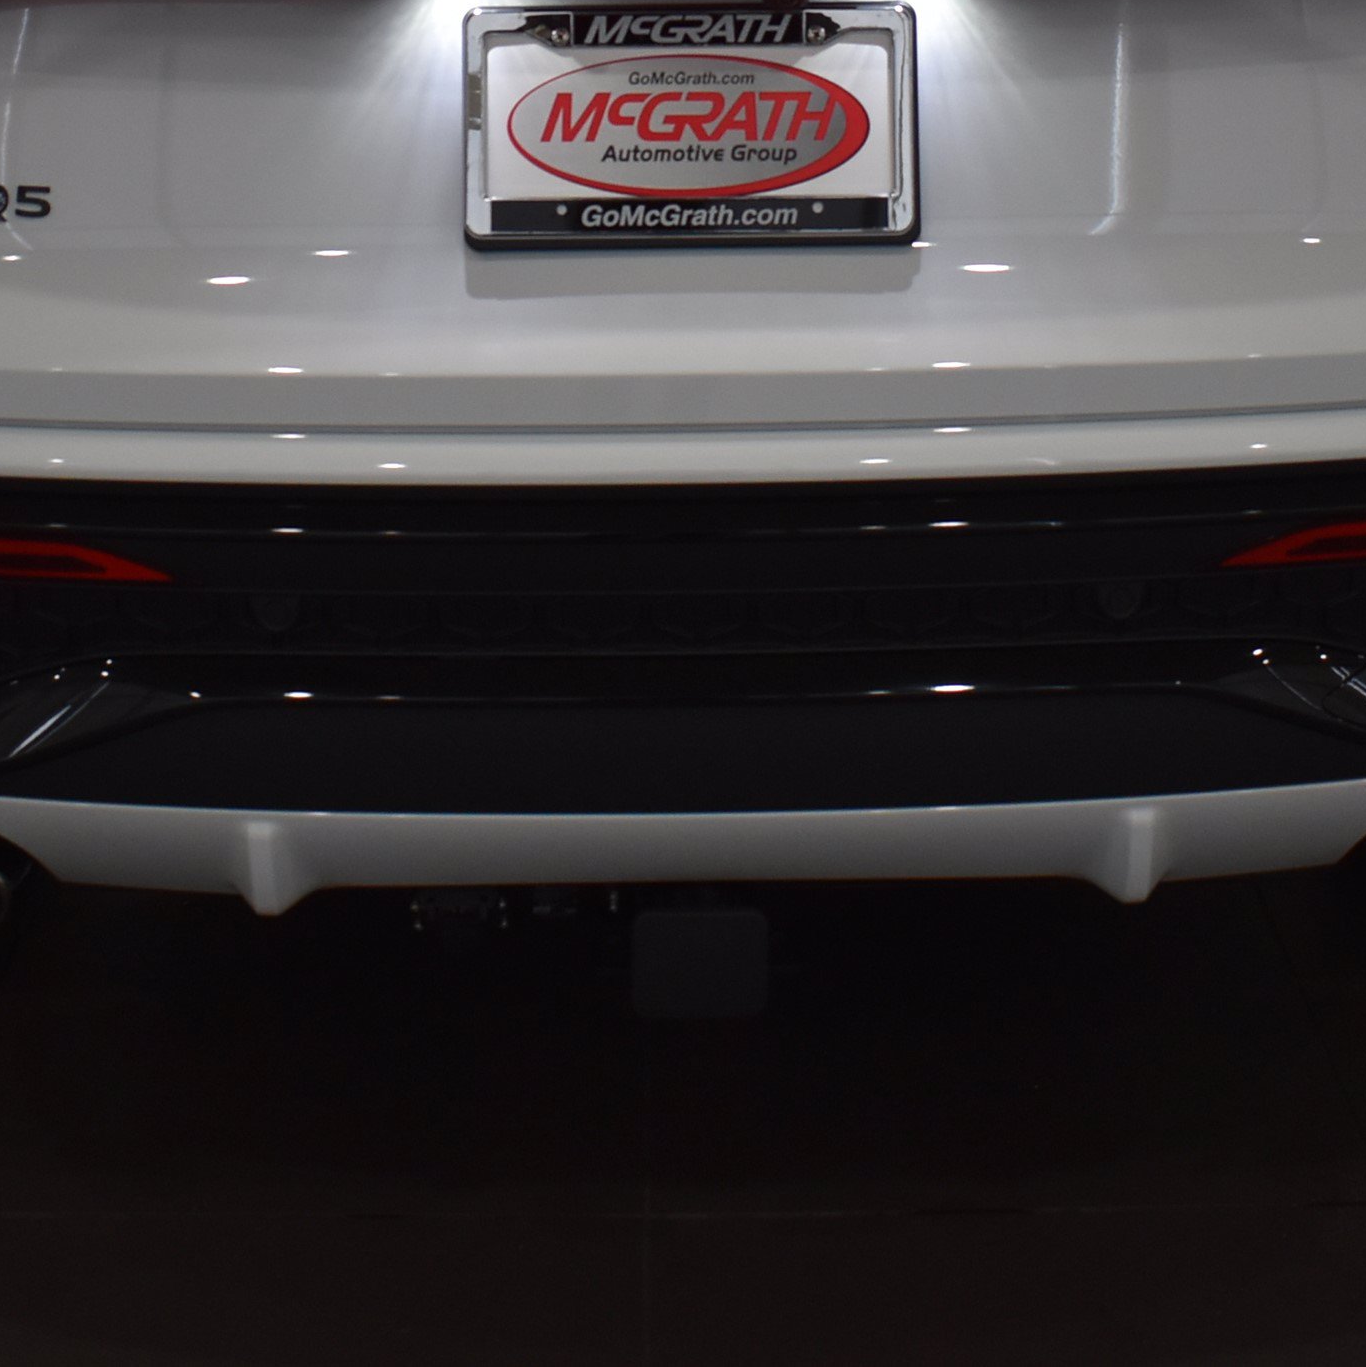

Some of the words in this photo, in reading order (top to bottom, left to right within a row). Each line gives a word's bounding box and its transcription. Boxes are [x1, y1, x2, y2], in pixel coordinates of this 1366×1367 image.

[628, 70, 756, 86] GoMcGrath.com
[600, 144, 725, 163] Automotive
[730, 143, 798, 165] Group
[581, 203, 799, 228] GoMcGrath.com
